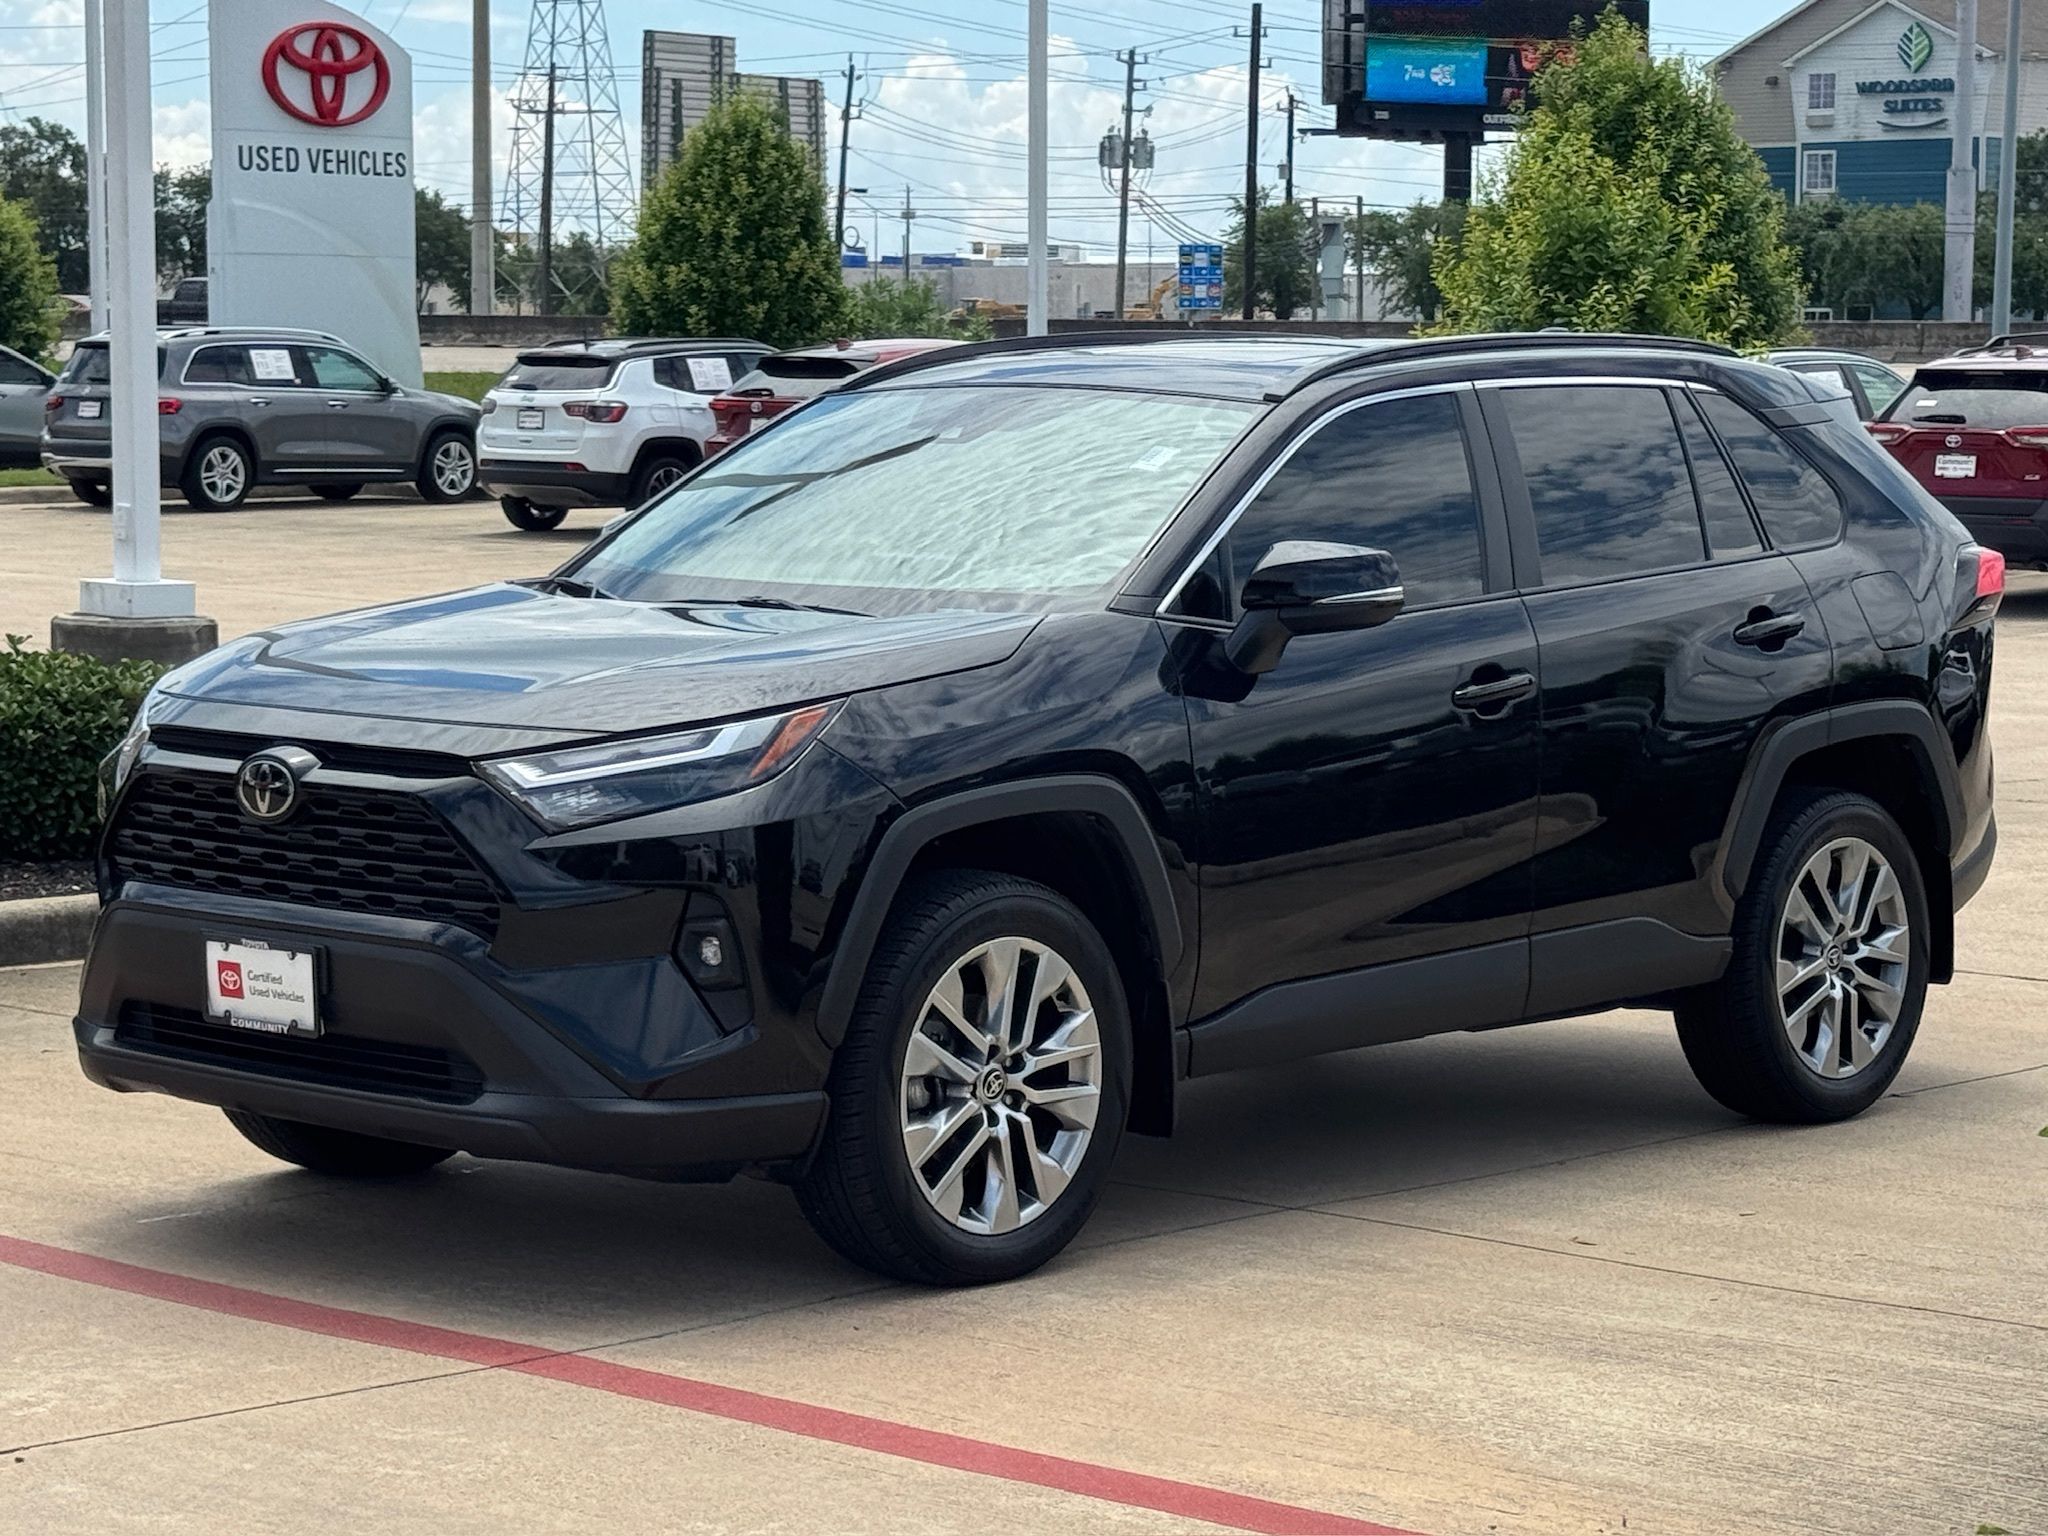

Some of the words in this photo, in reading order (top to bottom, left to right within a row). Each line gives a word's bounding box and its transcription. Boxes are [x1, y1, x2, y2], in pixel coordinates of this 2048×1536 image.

[1882, 98, 1945, 113] SUITES
[238, 145, 300, 173] USED
[306, 148, 407, 178] VEHICLES
[247, 969, 283, 985] Certified
[249, 986, 271, 998] Used
[270, 989, 306, 1004] Vehicles
[231, 1018, 290, 1034] COMMUNITY
